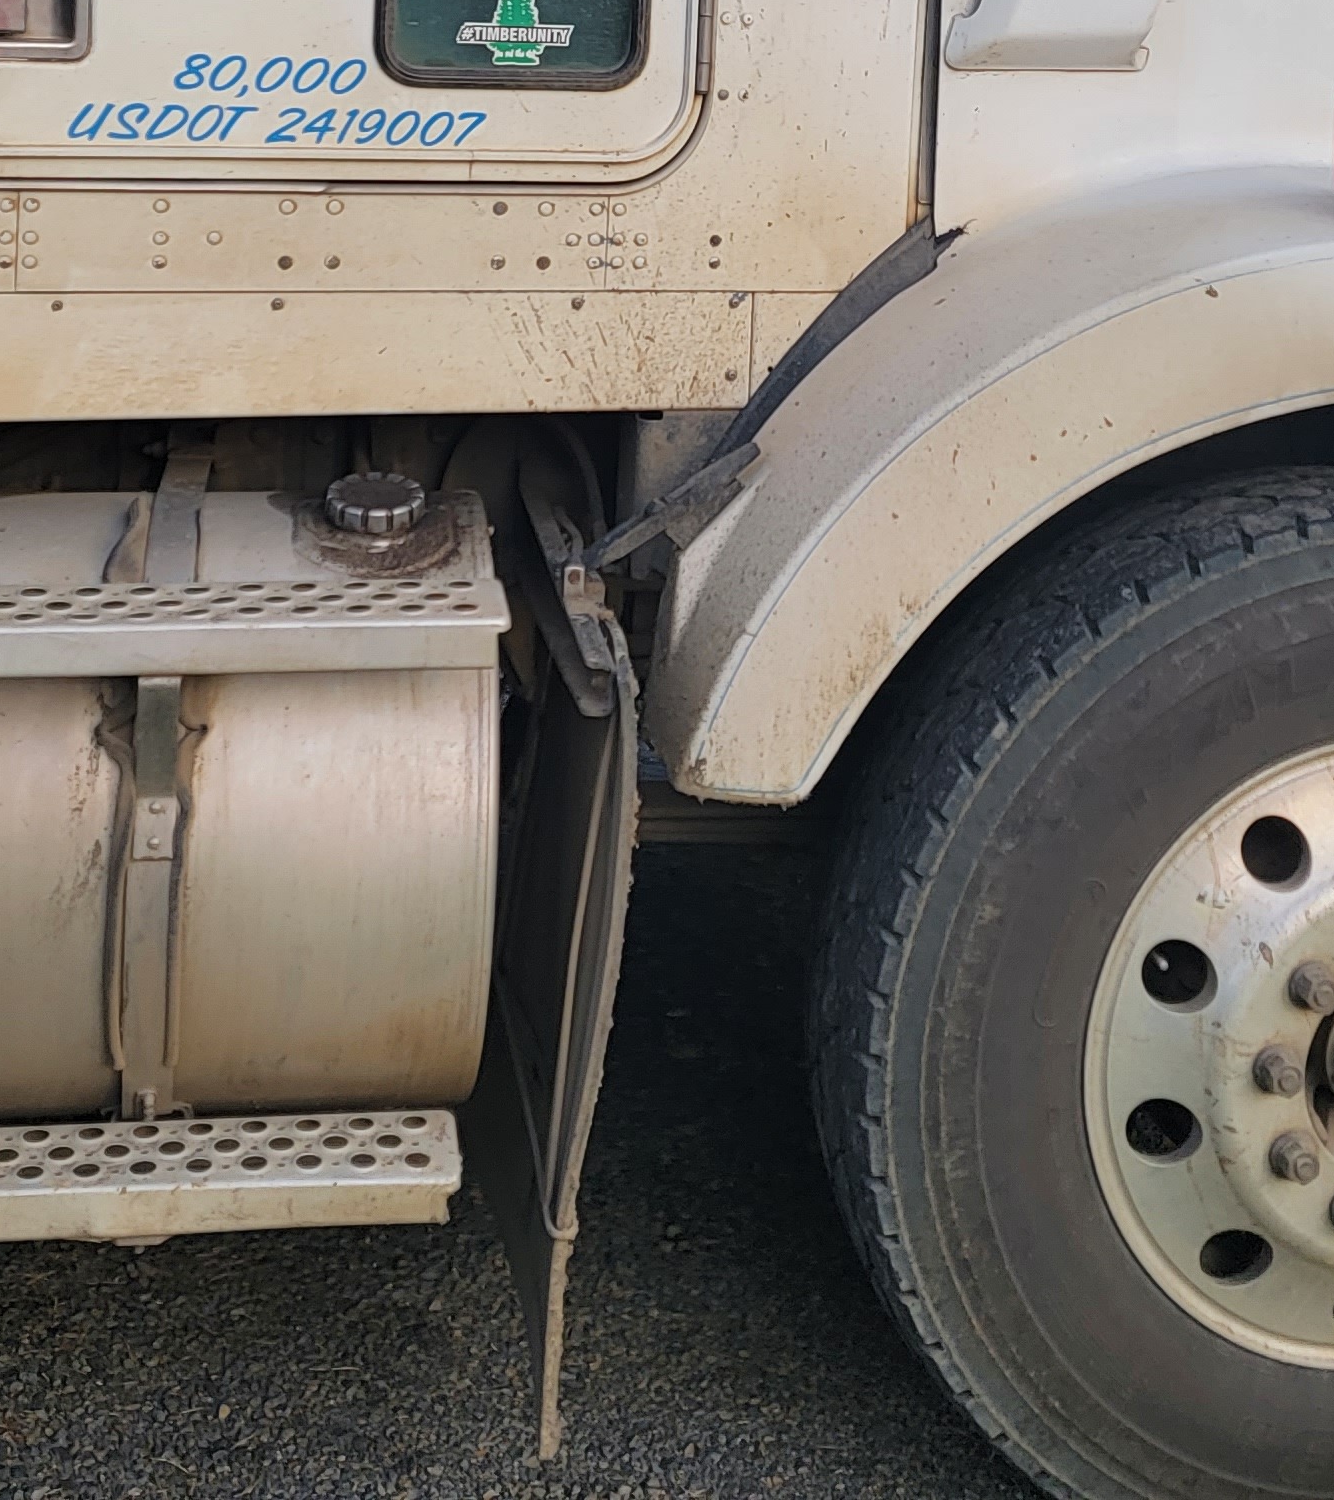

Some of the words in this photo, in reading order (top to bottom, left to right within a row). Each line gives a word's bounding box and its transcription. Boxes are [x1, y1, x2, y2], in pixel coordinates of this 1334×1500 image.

[461, 26, 568, 43] #TIMBERUNITY
[174, 53, 368, 98] 80,000
[68, 101, 259, 142] USDOT
[264, 107, 487, 147] 2419007
